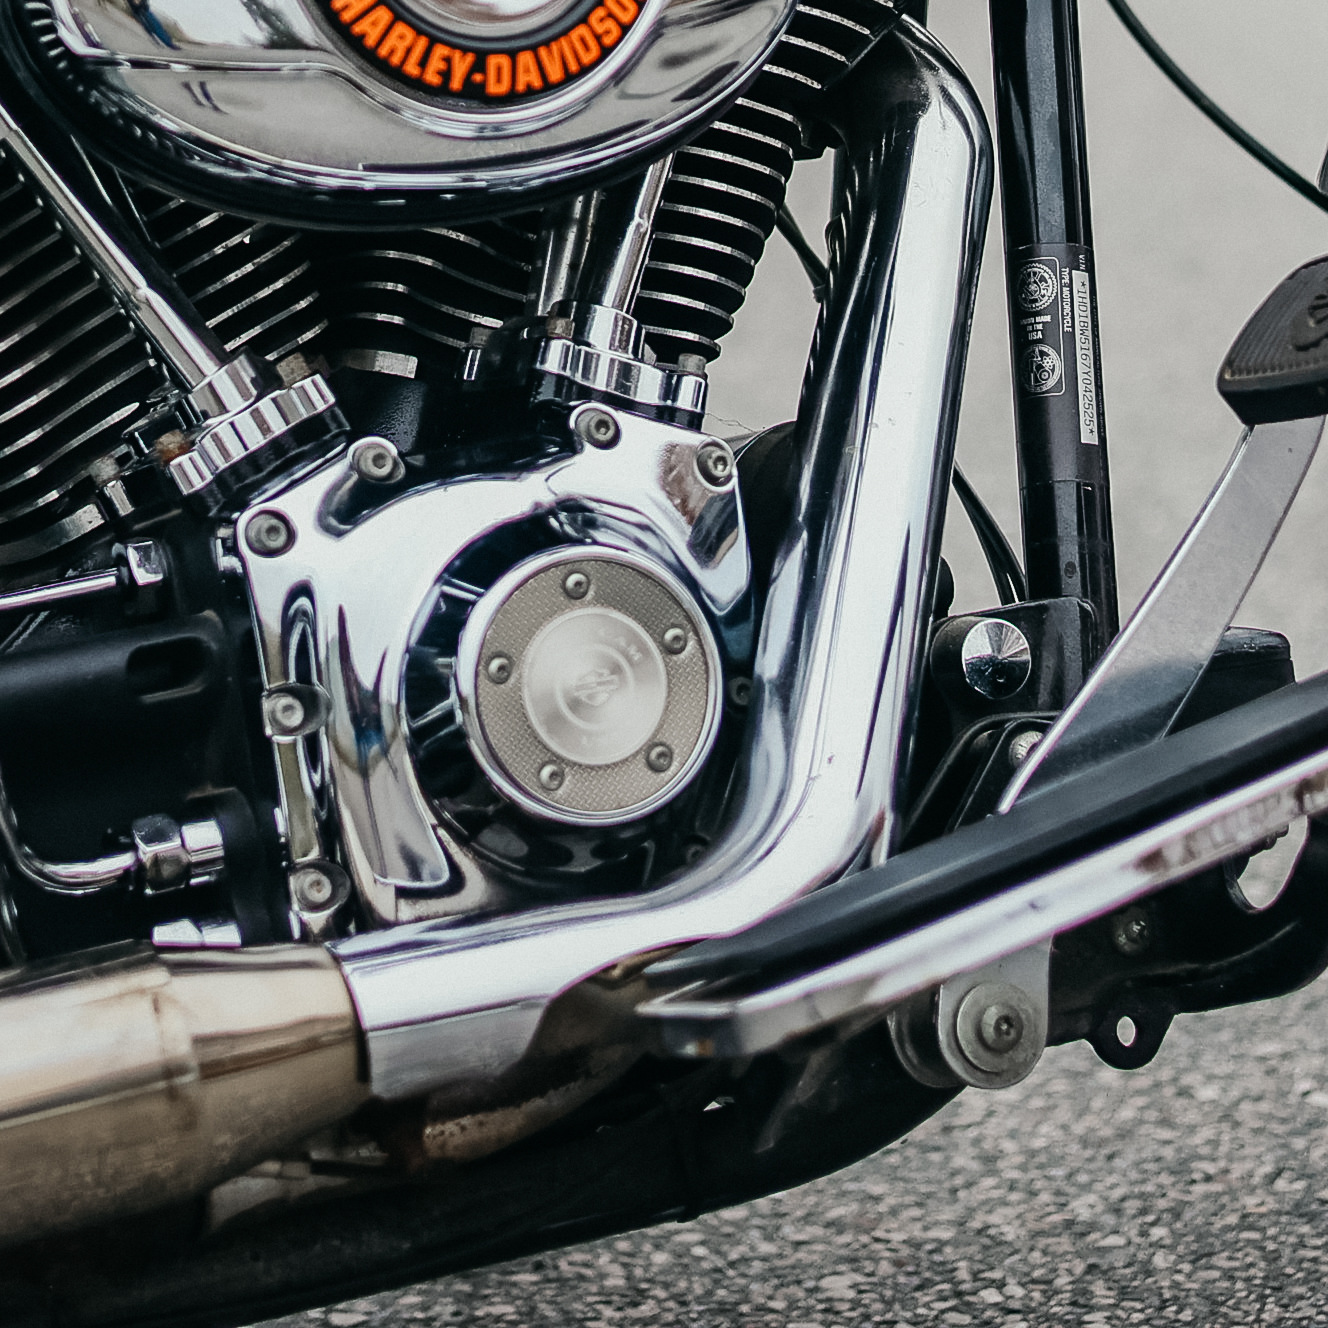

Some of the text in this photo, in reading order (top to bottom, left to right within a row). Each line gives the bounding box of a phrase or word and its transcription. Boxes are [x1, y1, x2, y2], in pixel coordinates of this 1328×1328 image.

[1061, 267, 1072, 332] TYPE: MOTORCYCLE
[1028, 331, 1043, 340] USA
